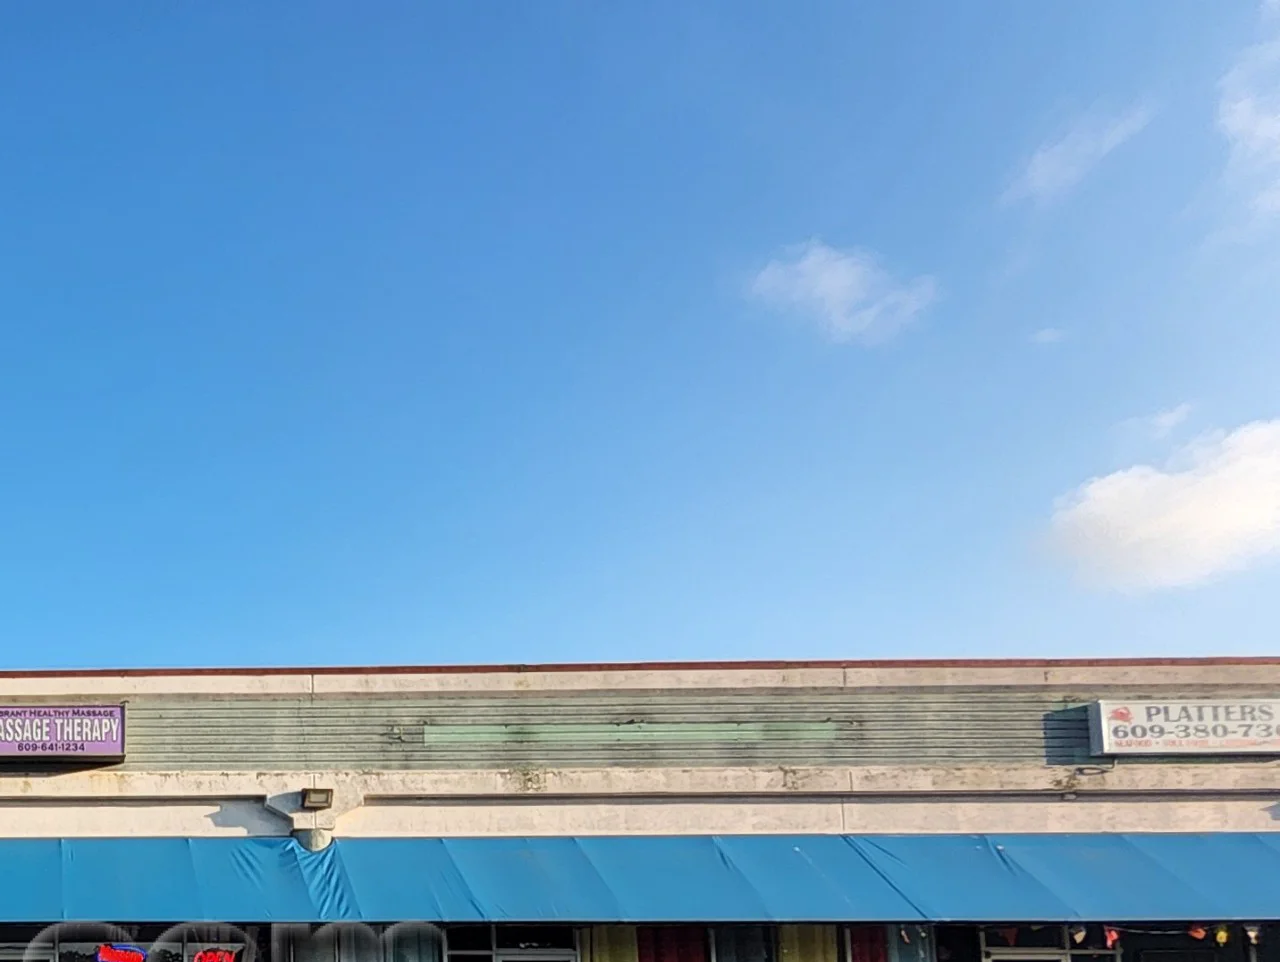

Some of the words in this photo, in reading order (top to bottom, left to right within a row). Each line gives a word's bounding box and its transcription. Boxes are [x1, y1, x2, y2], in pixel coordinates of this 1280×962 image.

[1145, 705, 1274, 722] PLATTERS
[54, 718, 120, 741] THERAPY
[1112, 724, 1280, 739] 609-380-73
[17, 743, 85, 752] 609-641-1234
